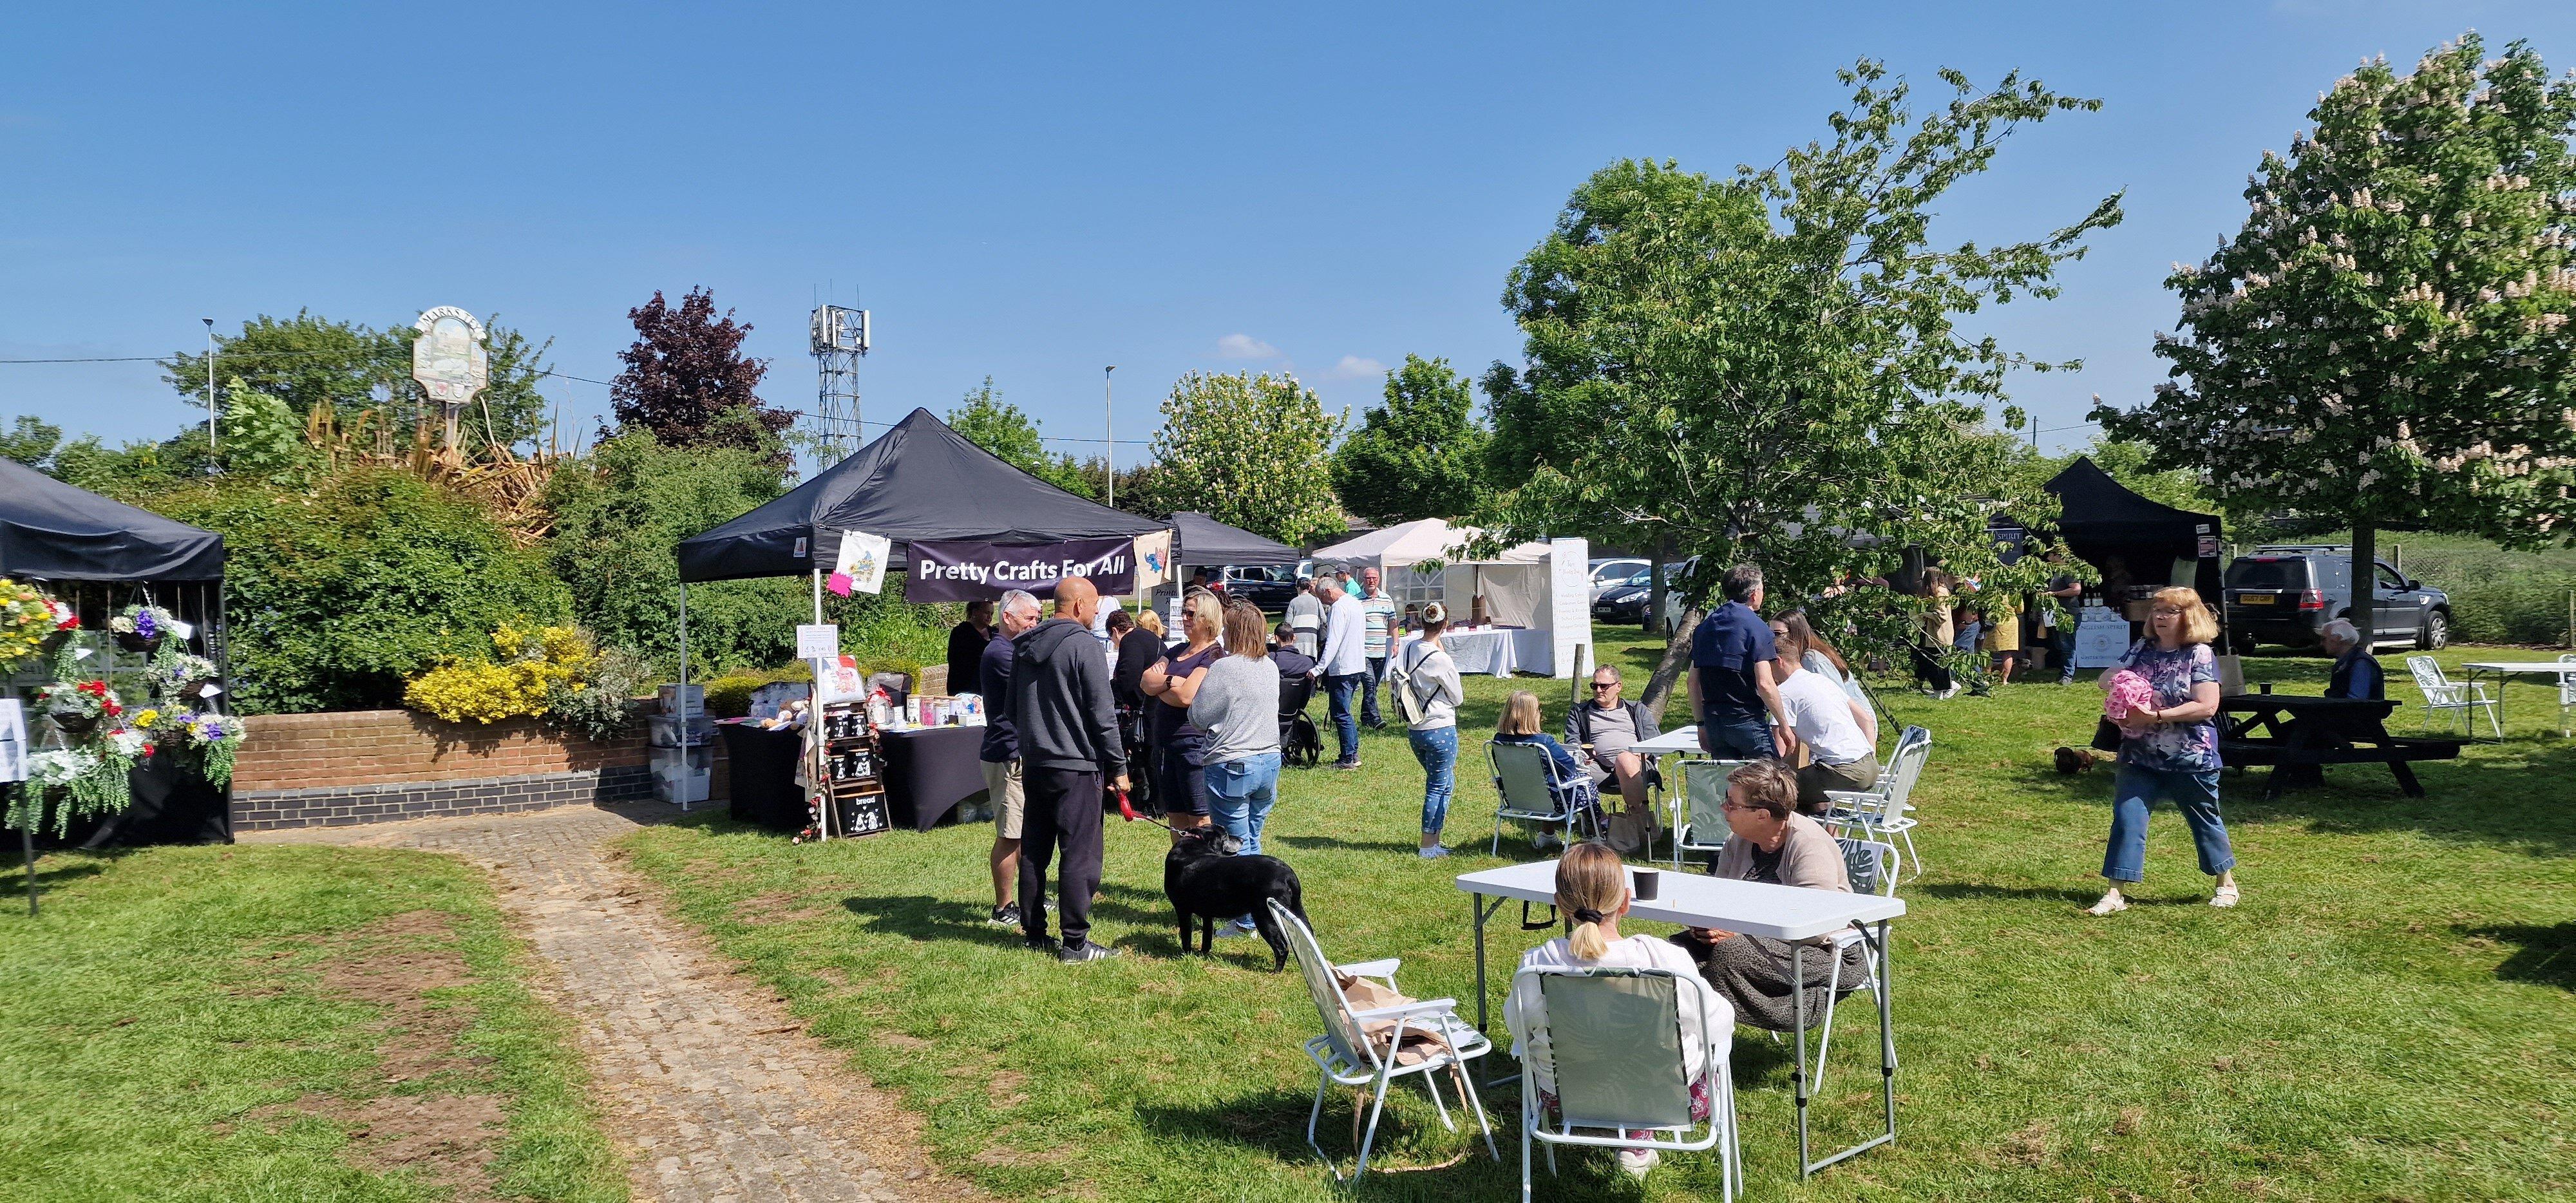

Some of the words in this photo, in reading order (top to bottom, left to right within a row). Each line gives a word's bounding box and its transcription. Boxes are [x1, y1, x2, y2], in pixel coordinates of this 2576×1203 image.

[422, 308, 460, 326] MARKS
[920, 559, 990, 585] Pretty
[994, 559, 1057, 580] Crafts
[1062, 559, 1094, 578] For
[1098, 556, 1126, 576] All
[856, 795, 876, 806] bread
